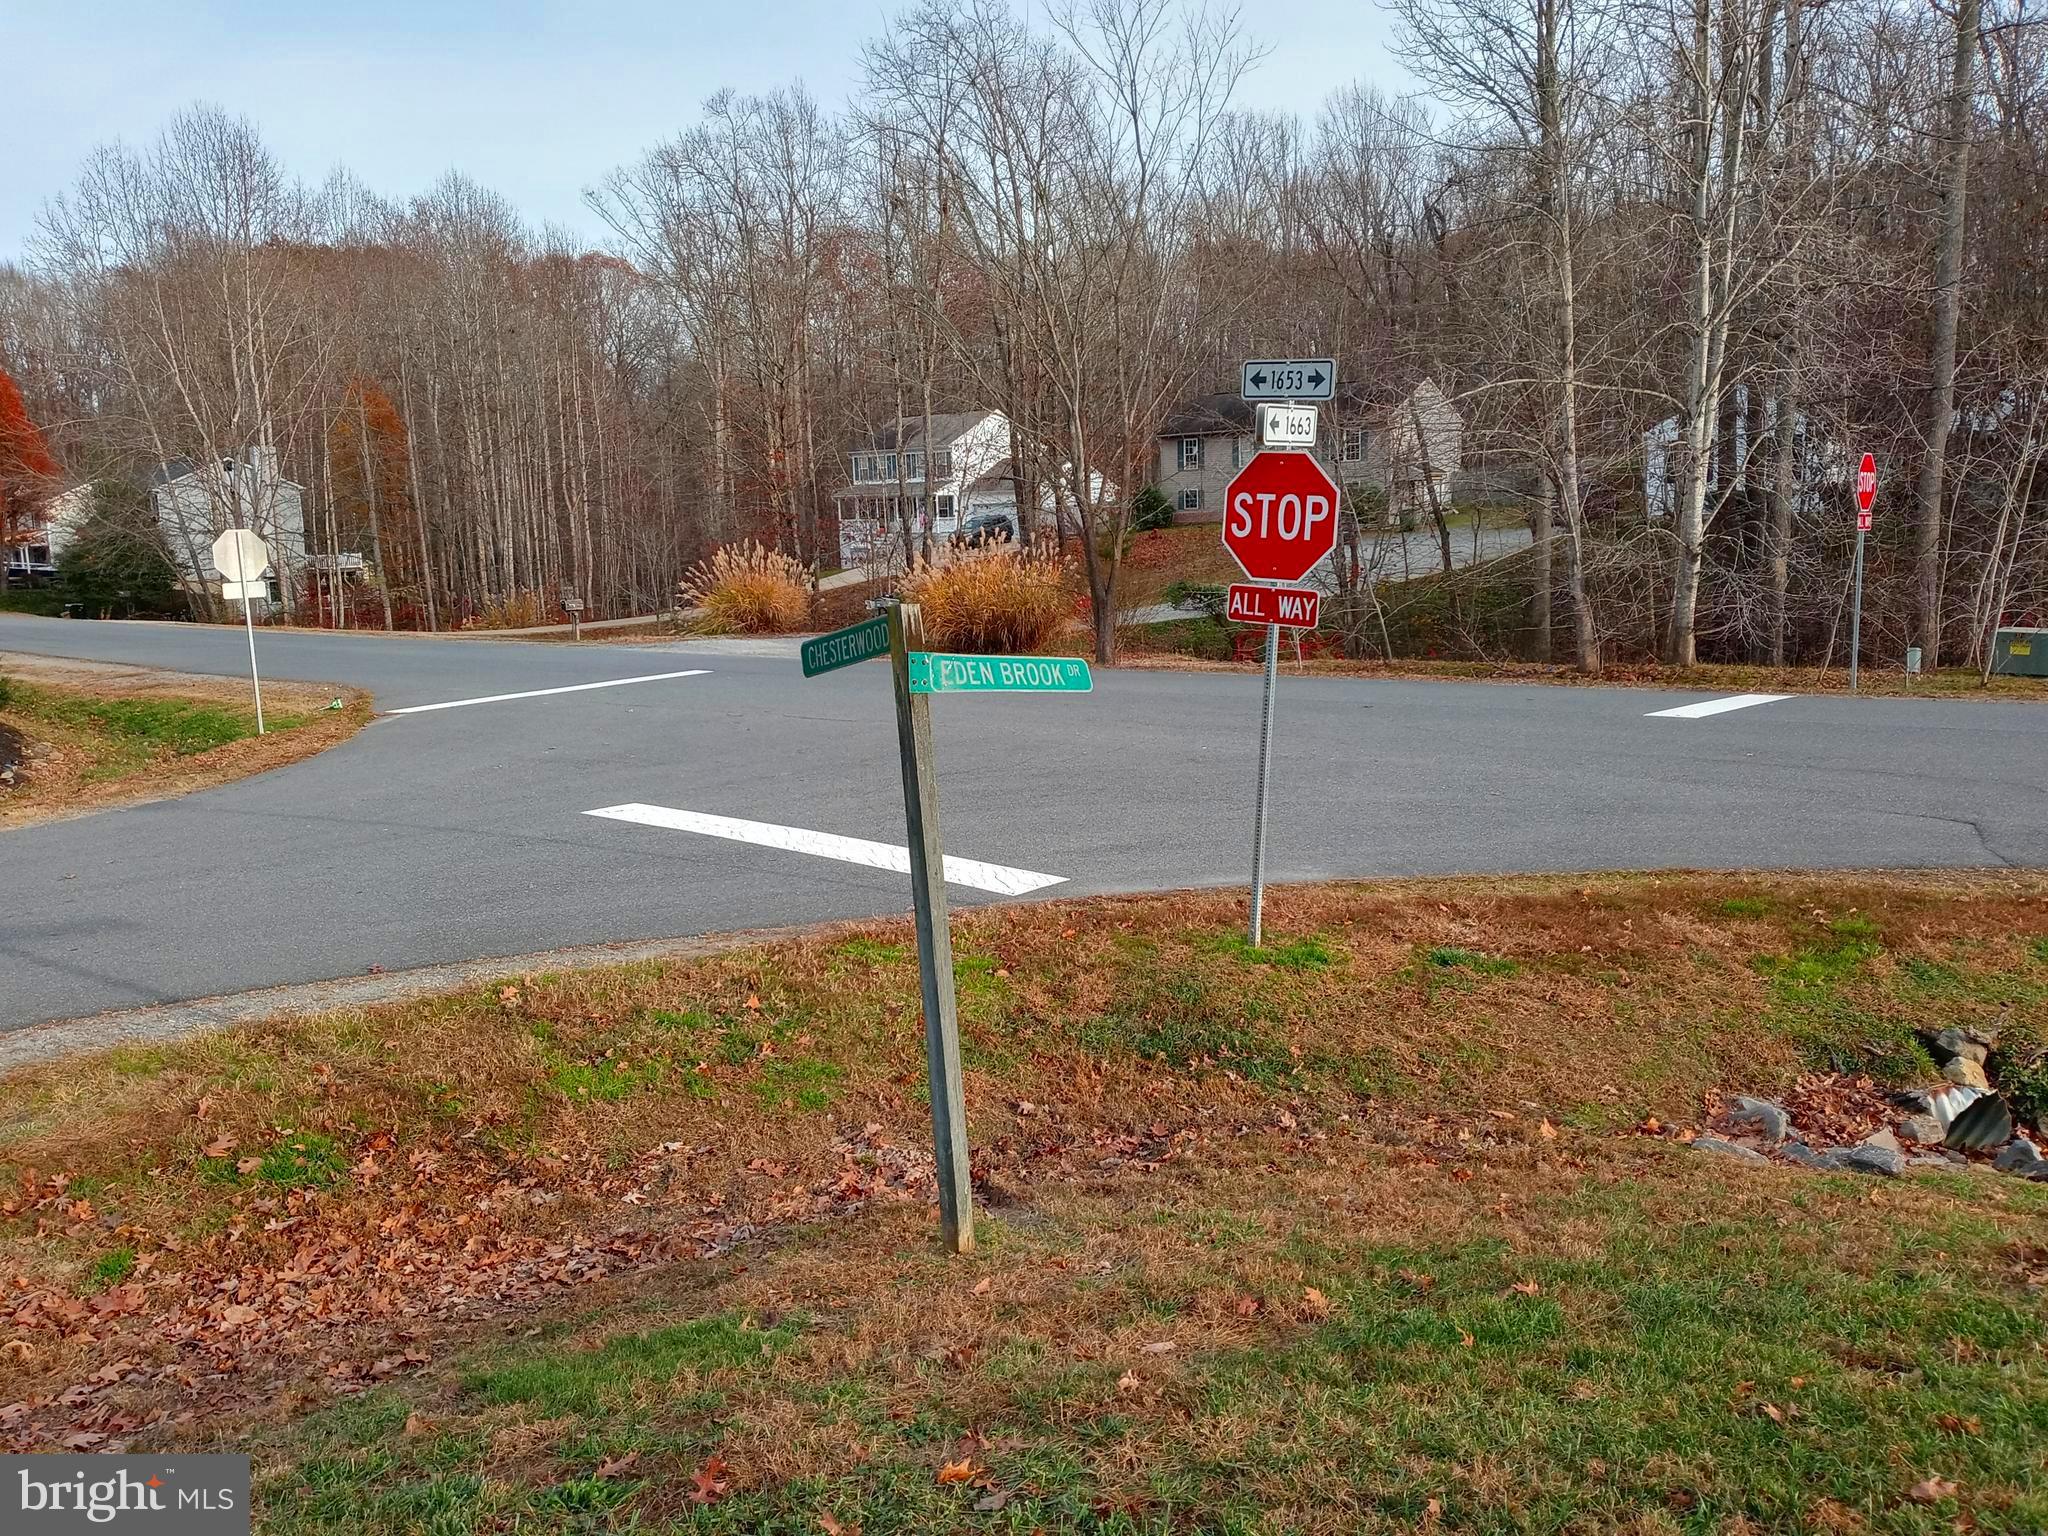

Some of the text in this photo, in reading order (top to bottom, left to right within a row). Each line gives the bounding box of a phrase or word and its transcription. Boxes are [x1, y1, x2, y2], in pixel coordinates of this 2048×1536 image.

[1271, 370, 1303, 390] 1653
[1285, 415, 1312, 436] 1663
[1859, 471, 1875, 493] STOP
[1231, 492, 1329, 541] STOP
[1230, 592, 1316, 621] ALL WAY
[808, 623, 890, 669] CHESTERWOOD
[940, 660, 1081, 686] EDEN BROOK DR
